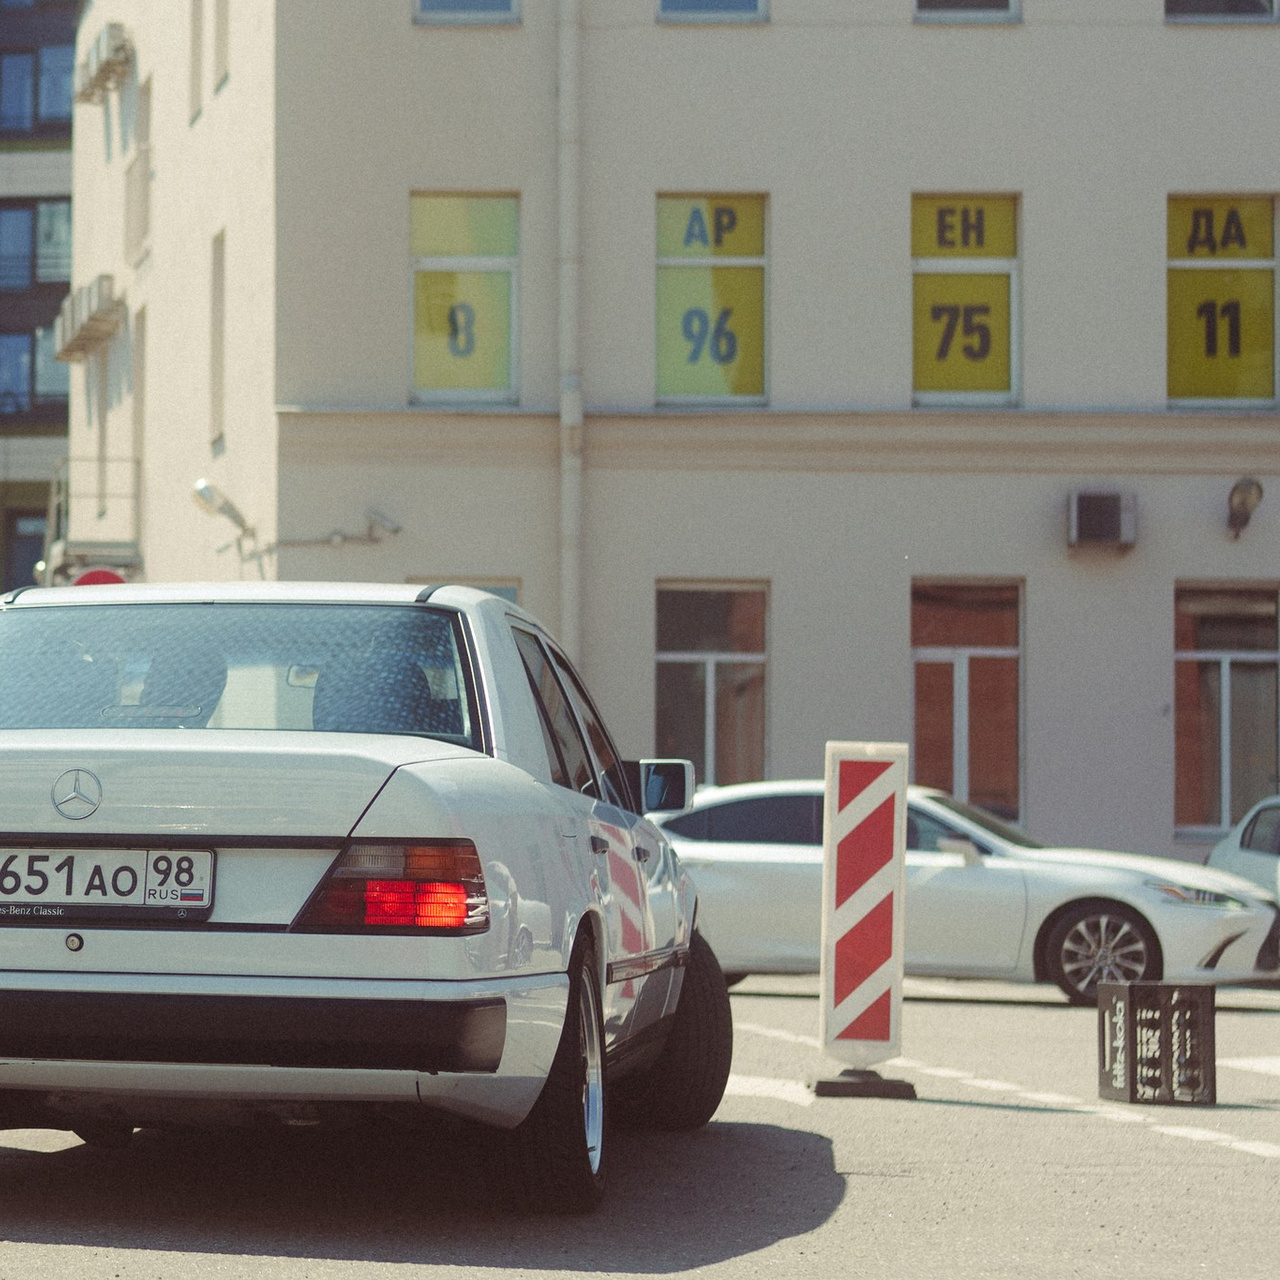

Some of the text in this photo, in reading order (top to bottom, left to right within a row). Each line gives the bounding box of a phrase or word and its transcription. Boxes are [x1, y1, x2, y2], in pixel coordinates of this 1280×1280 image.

[683, 206, 1247, 255] АР ЕН ДА
[447, 298, 1242, 366] 8 96 75 11
[152, 855, 194, 888] 98
[33, 905, 65, 916] Classic
[147, 889, 179, 901] RUS
